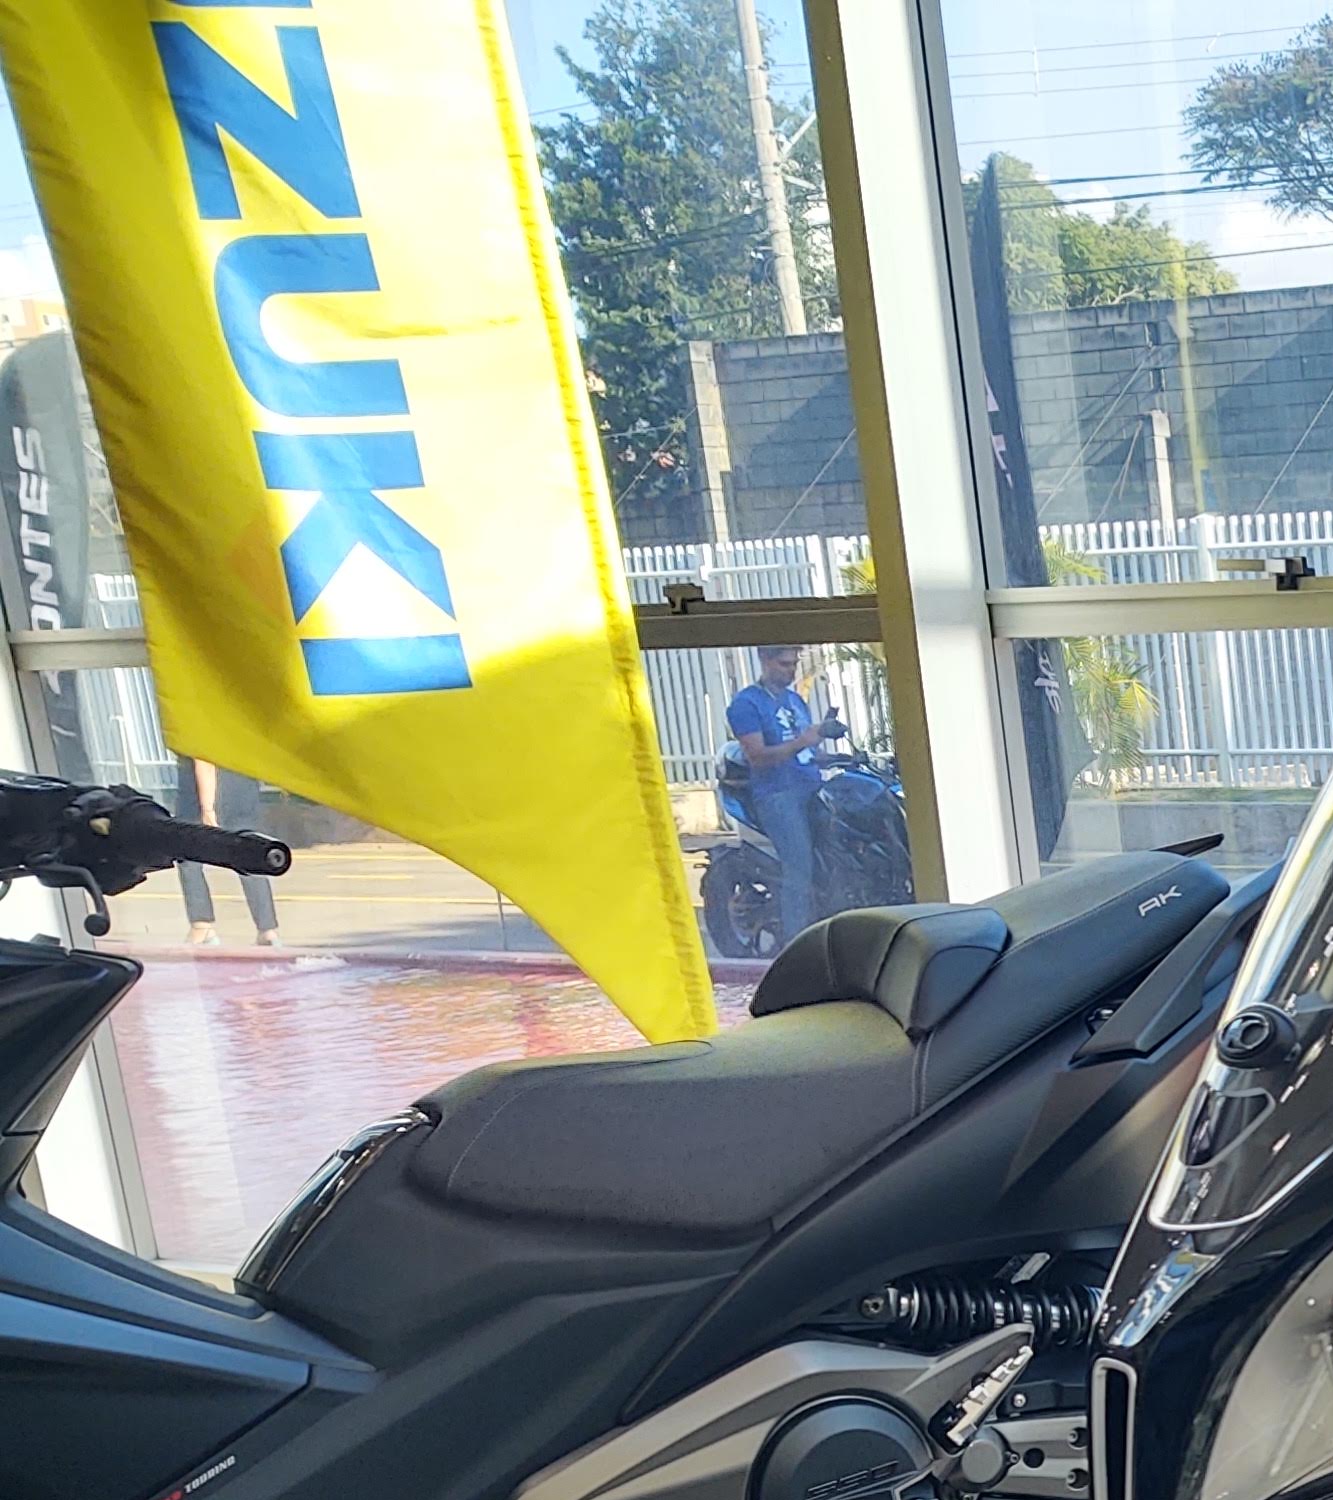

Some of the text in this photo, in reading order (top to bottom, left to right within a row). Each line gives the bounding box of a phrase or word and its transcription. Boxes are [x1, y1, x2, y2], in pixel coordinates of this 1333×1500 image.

[151, 0, 473, 696] ZUKI
[1138, 884, 1182, 917] AK
[184, 1455, 235, 1494] TOURING
